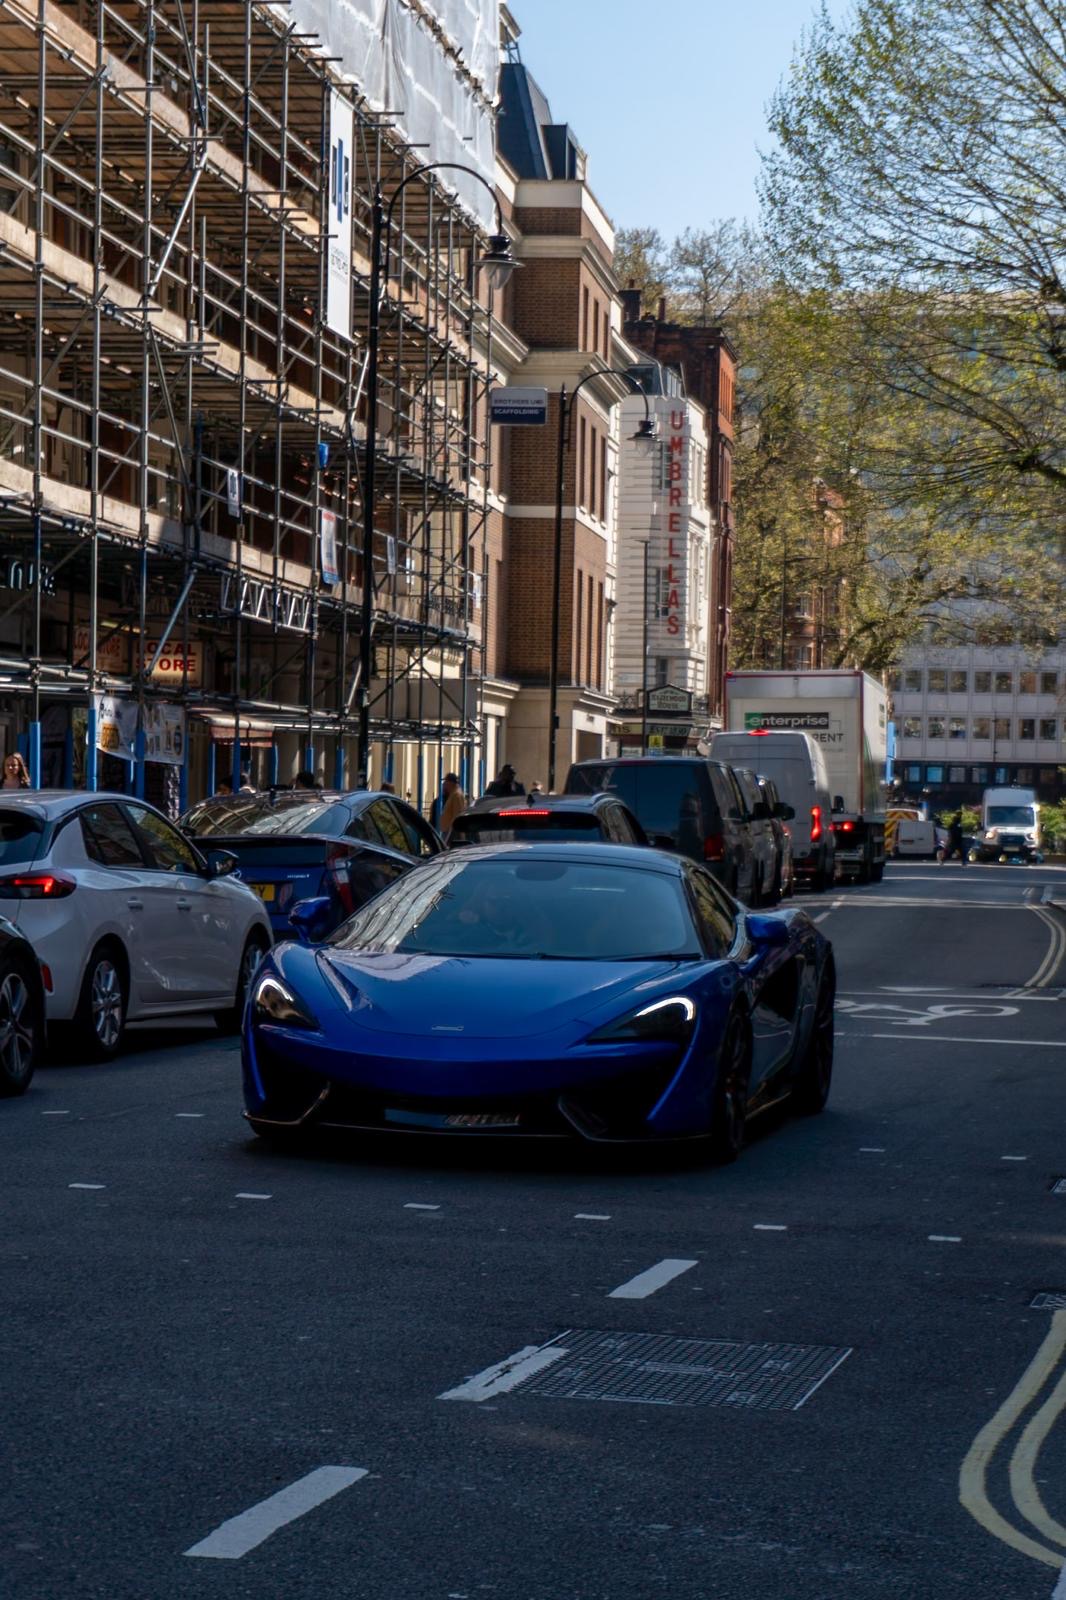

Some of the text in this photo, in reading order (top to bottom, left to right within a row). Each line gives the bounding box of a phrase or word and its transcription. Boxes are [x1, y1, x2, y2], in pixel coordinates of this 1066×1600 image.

[667, 410, 684, 635] UMBRELLAS
[136, 641, 197, 656] LOCAL
[748, 714, 828, 728] enterprise
